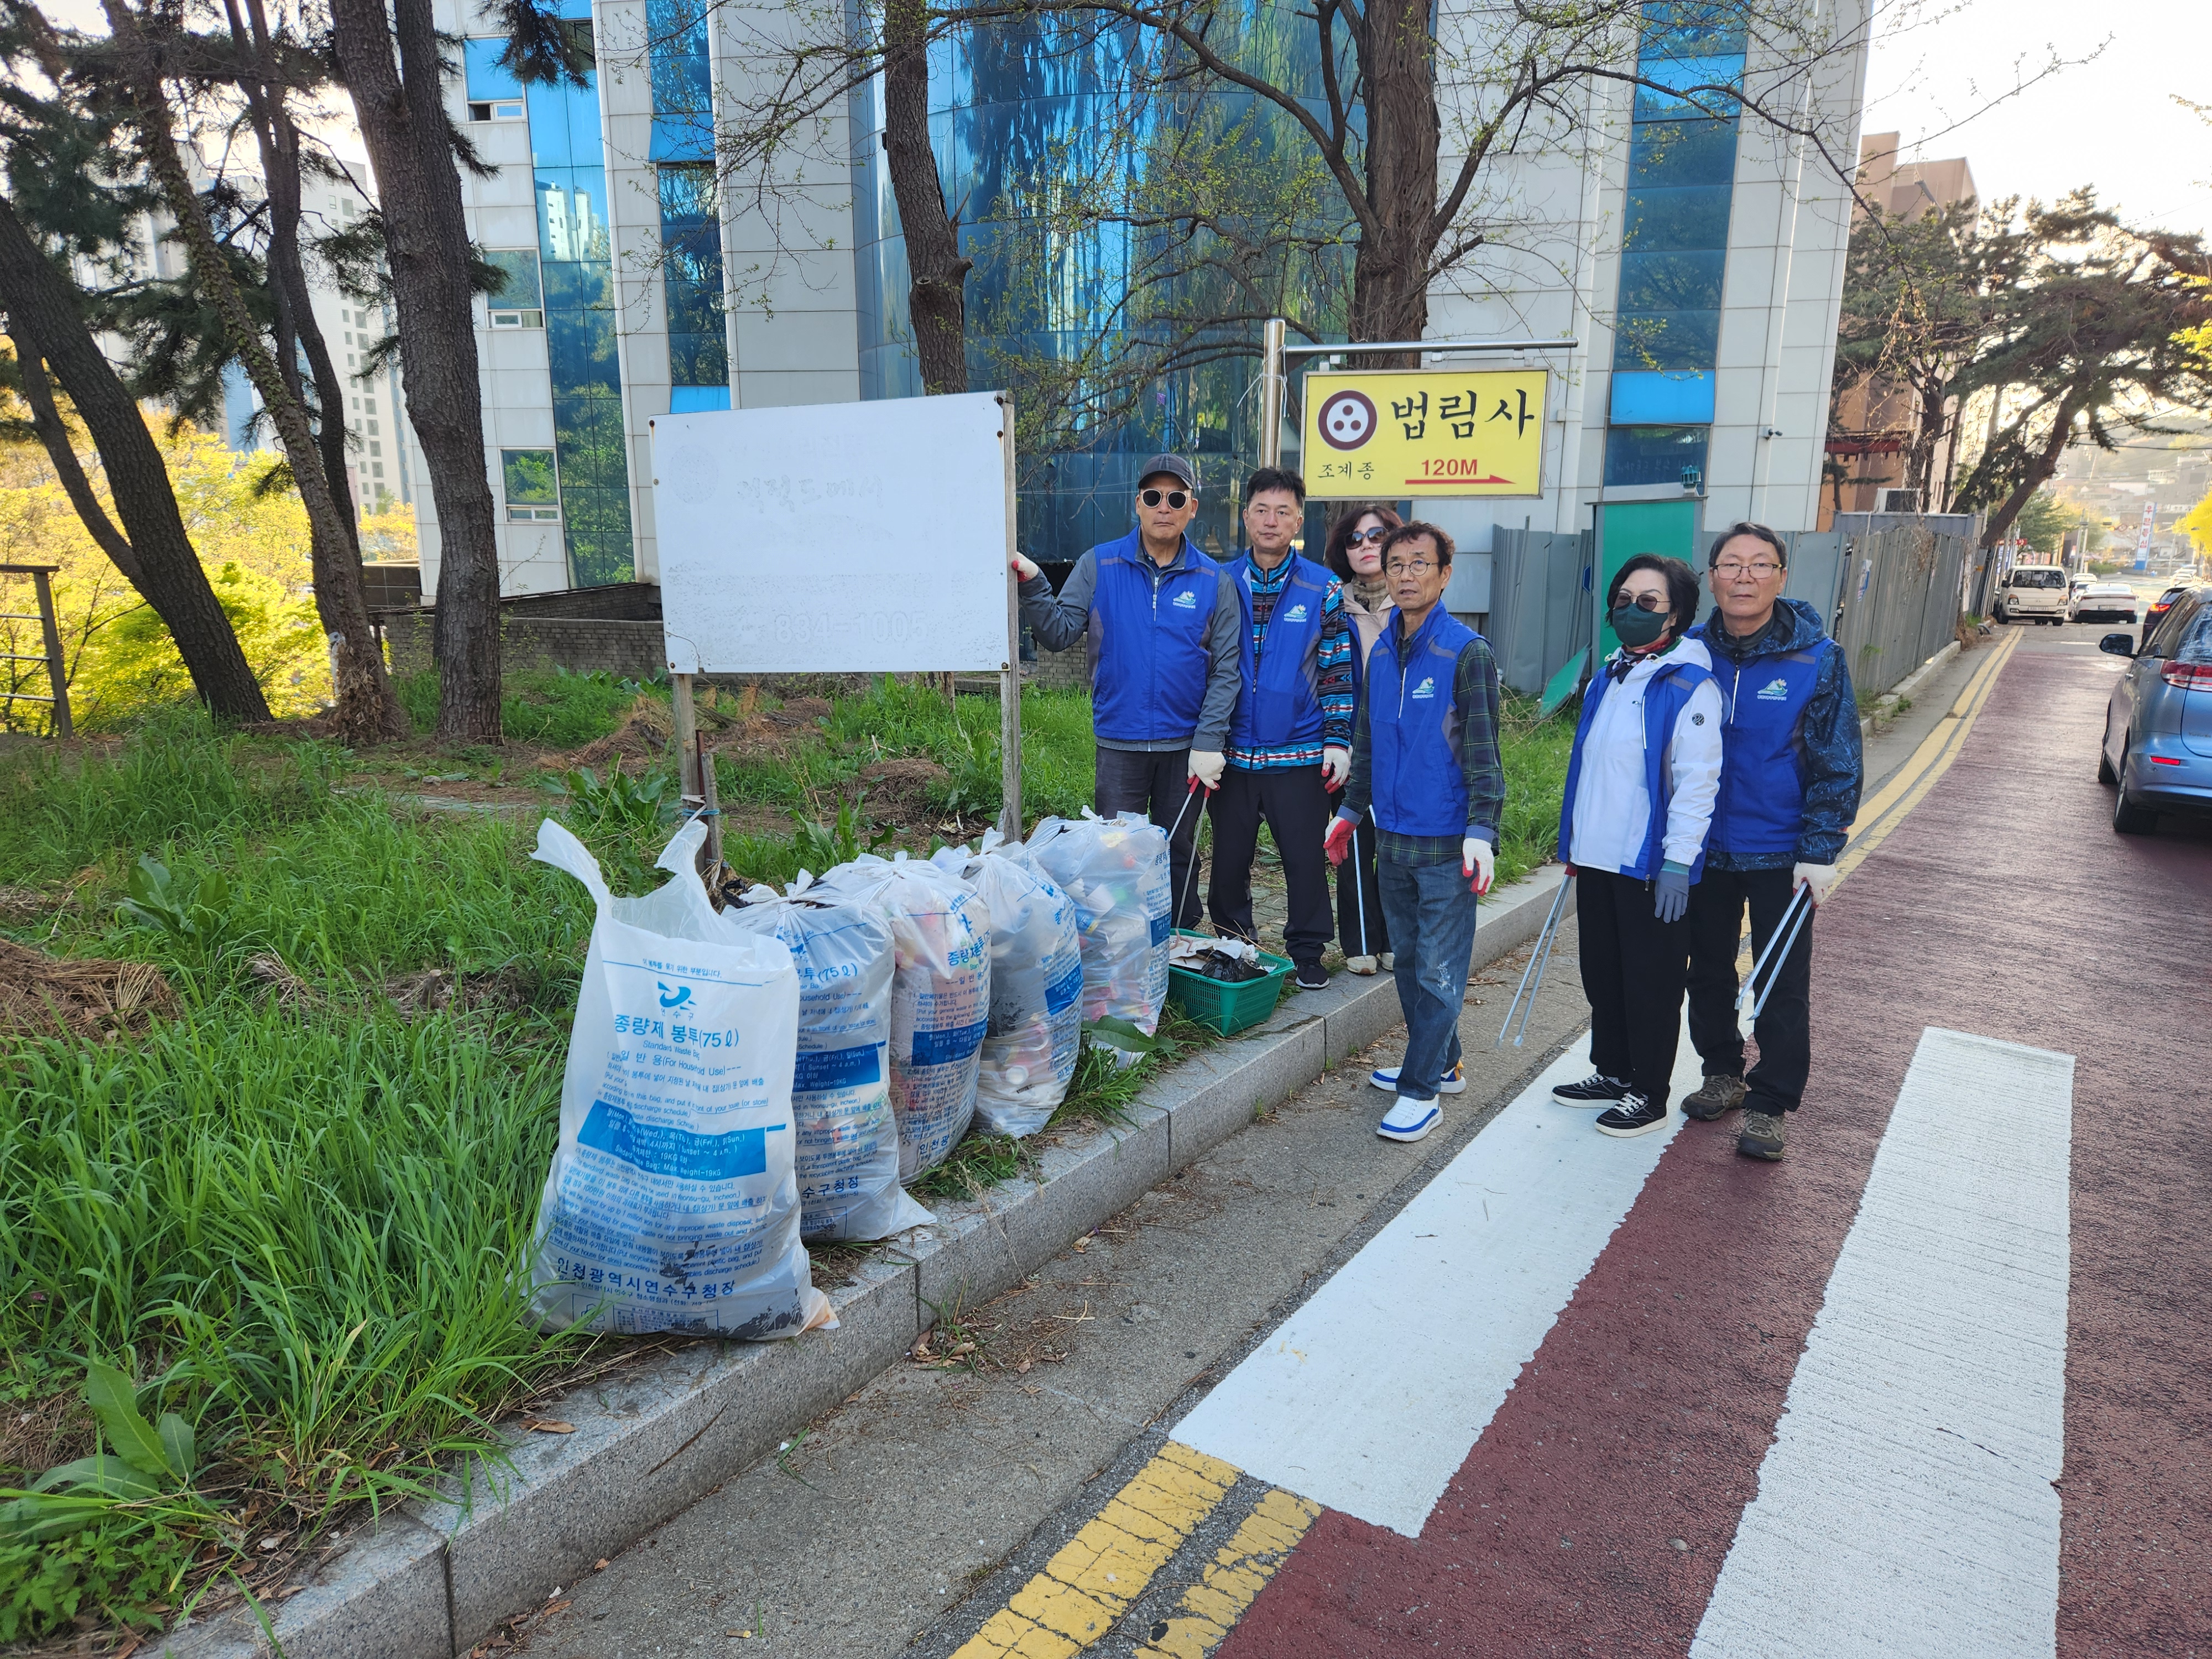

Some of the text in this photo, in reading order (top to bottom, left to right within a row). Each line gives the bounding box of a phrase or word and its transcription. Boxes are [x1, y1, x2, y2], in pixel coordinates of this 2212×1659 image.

[1390, 388, 1535, 441] 법림사
[1317, 461, 1375, 481] 조계종
[1421, 459, 1478, 476] 120M
[615, 1014, 664, 1040] 종량제
[715, 1105, 727, 1114] your
[742, 1099, 750, 1107] (or
[646, 1115, 674, 1125] discharge
[709, 1182, 735, 1192] 있습니다.
[735, 1227, 747, 1235] and
[557, 1257, 735, 1301] 인천광역시연수구청장
